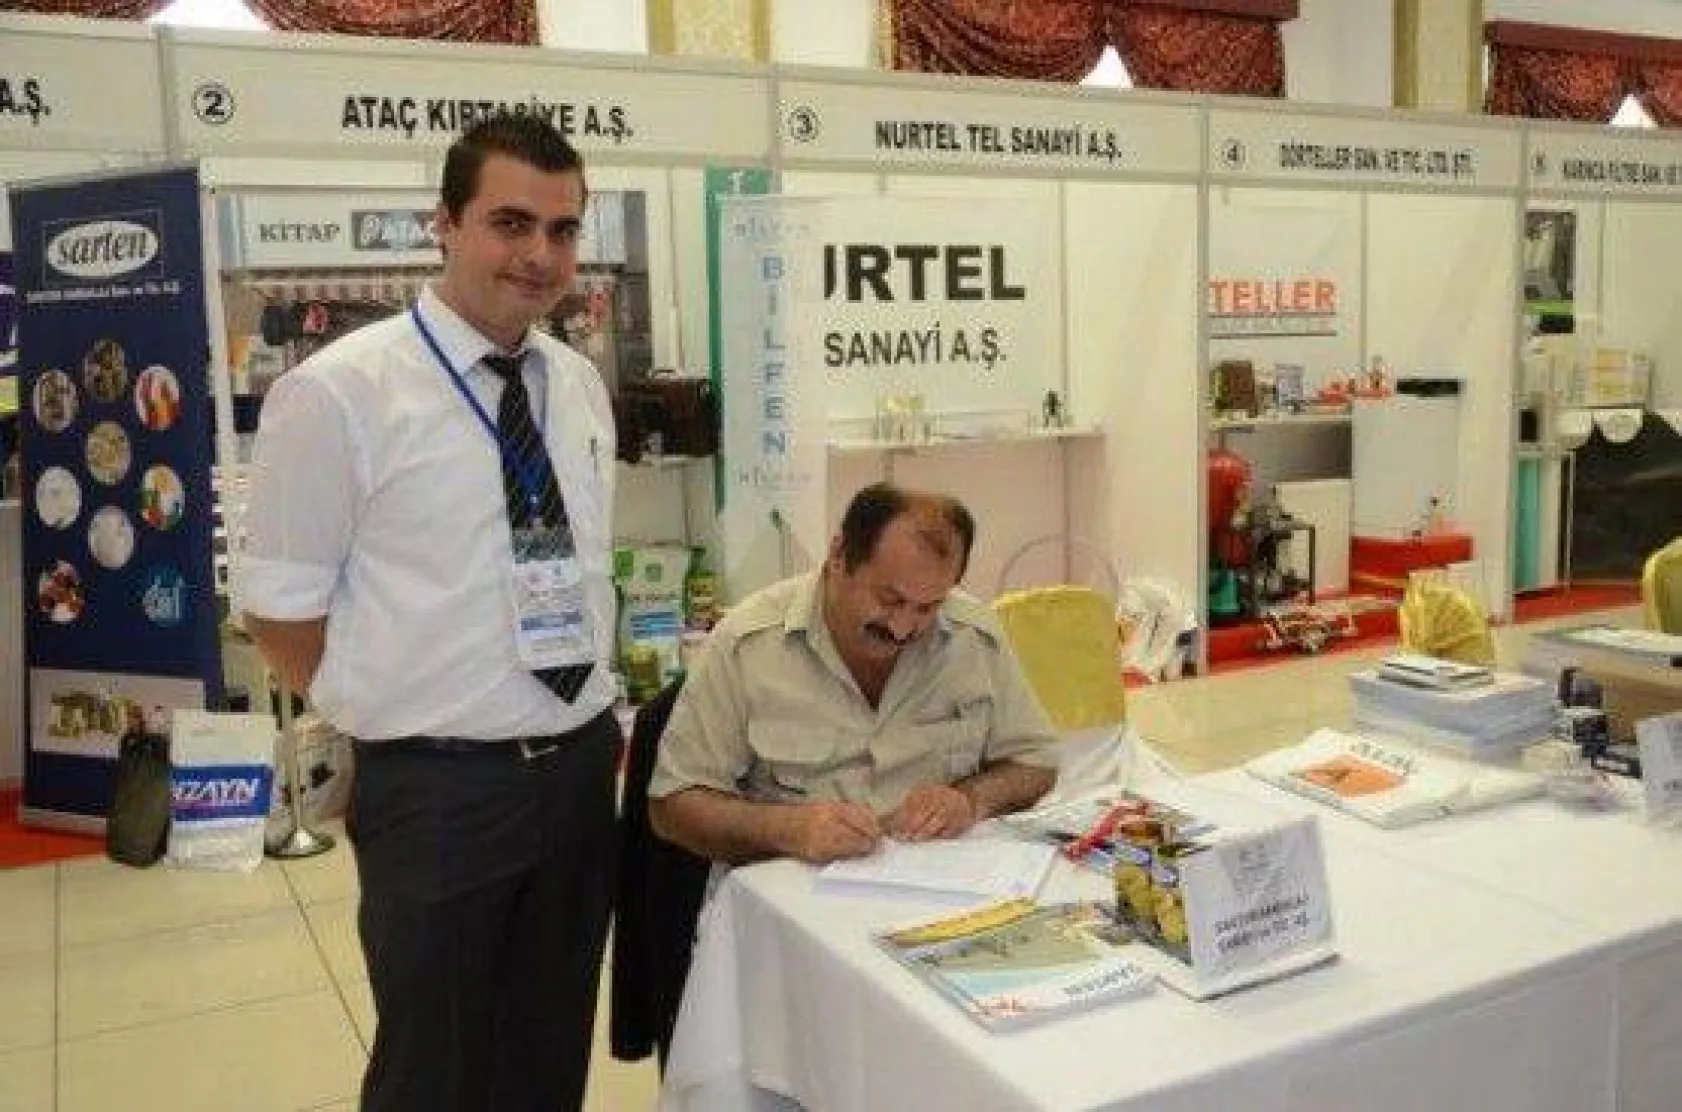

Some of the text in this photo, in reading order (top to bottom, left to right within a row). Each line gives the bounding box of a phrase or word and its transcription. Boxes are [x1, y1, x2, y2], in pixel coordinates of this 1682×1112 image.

[341, 96, 418, 139] ATAÇ
[585, 104, 635, 143] A.Ş.
[876, 121, 1122, 163] NURTEL TEL SANAYİ A.Ş.
[57, 231, 147, 264] sarten
[259, 218, 340, 242] KİTAP
[823, 321, 1007, 371] SANAYİ A.Ş.
